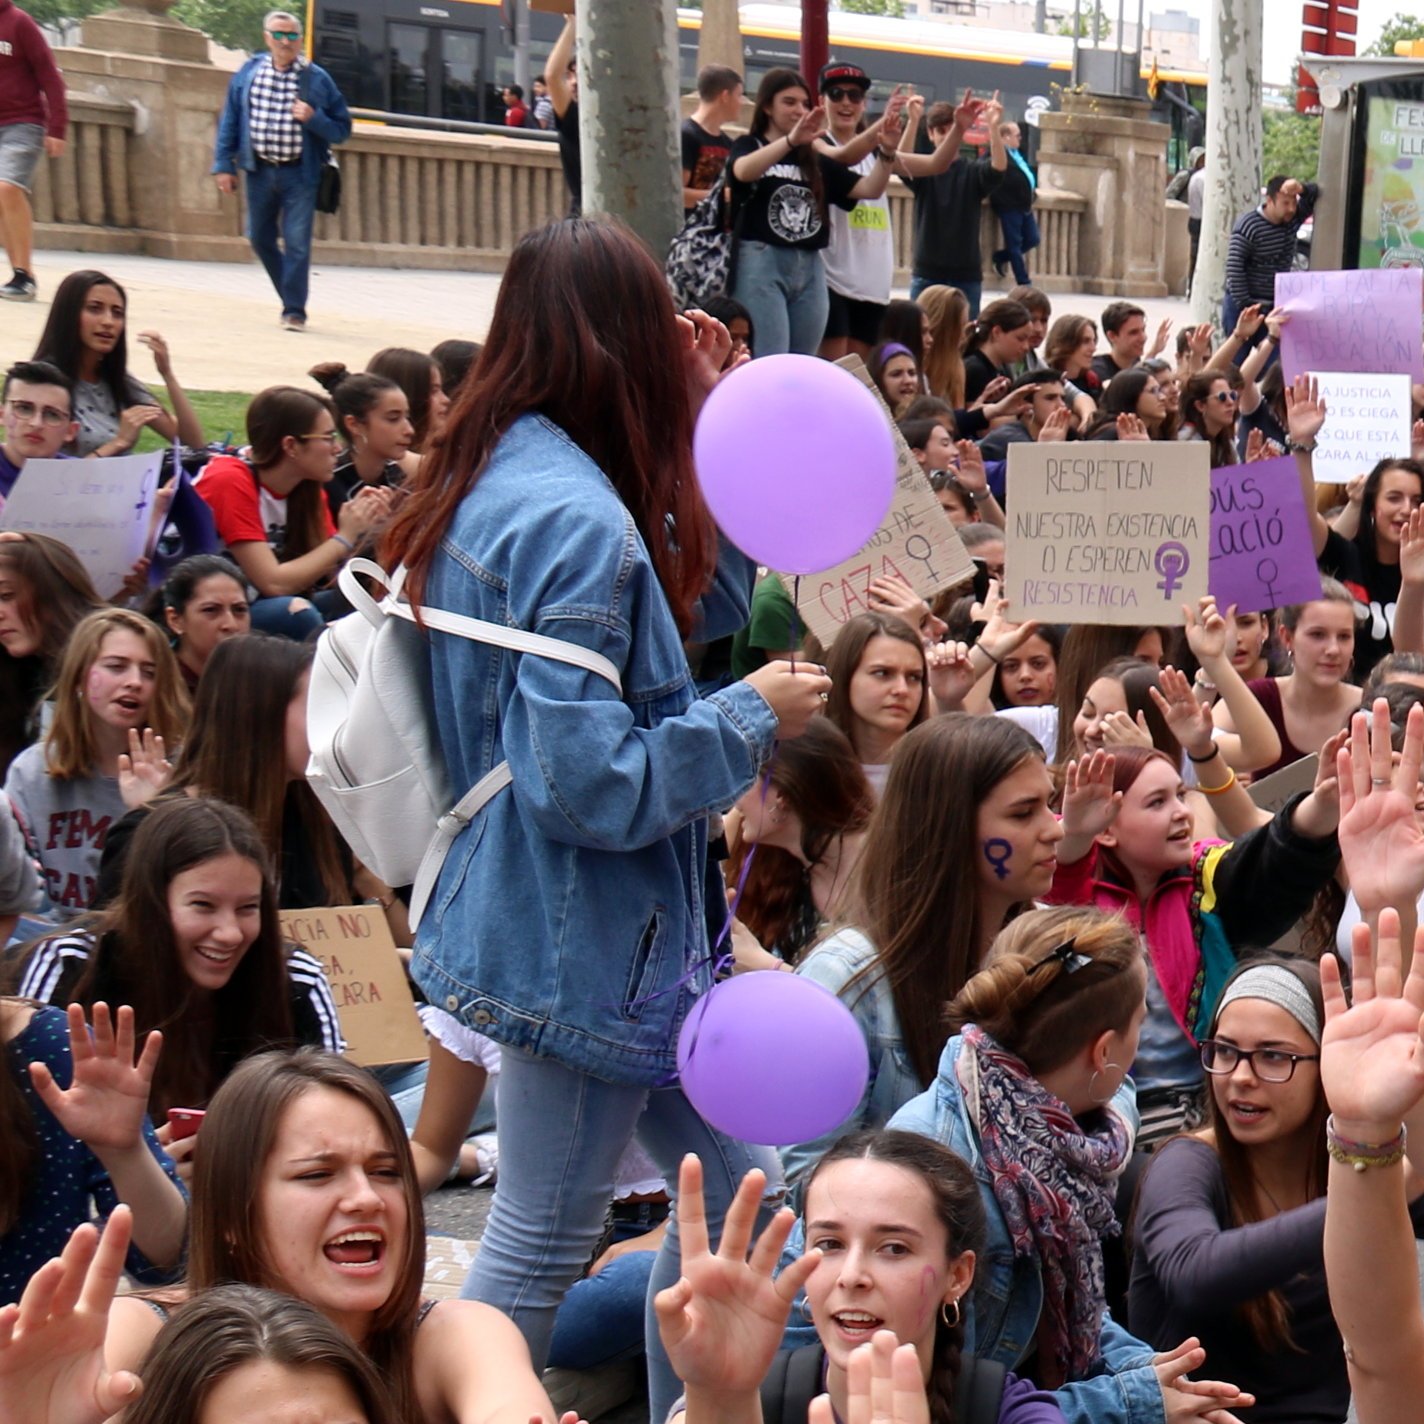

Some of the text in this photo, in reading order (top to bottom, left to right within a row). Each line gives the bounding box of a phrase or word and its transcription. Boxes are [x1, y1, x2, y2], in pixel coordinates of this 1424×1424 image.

[854, 207, 882, 226] RUN
[1334, 386, 1392, 399] JUSTICIA
[1341, 407, 1355, 418] ES
[1359, 407, 1399, 419] CIEGA
[1334, 429, 1363, 442] QUE
[1367, 429, 1400, 443] ESTÁ
[1315, 448, 1352, 461] CARA
[1355, 450, 1372, 463] AL
[1046, 458, 1153, 494] RESPETEN
[892, 503, 925, 534] DE
[1016, 512, 1198, 540] NUESTRA EXISTENCIA
[1042, 545, 1151, 574] O ESPEREN
[1024, 579, 1138, 608] RESISTENCIA
[337, 914, 371, 939] NO
[332, 982, 382, 1008] CARA
